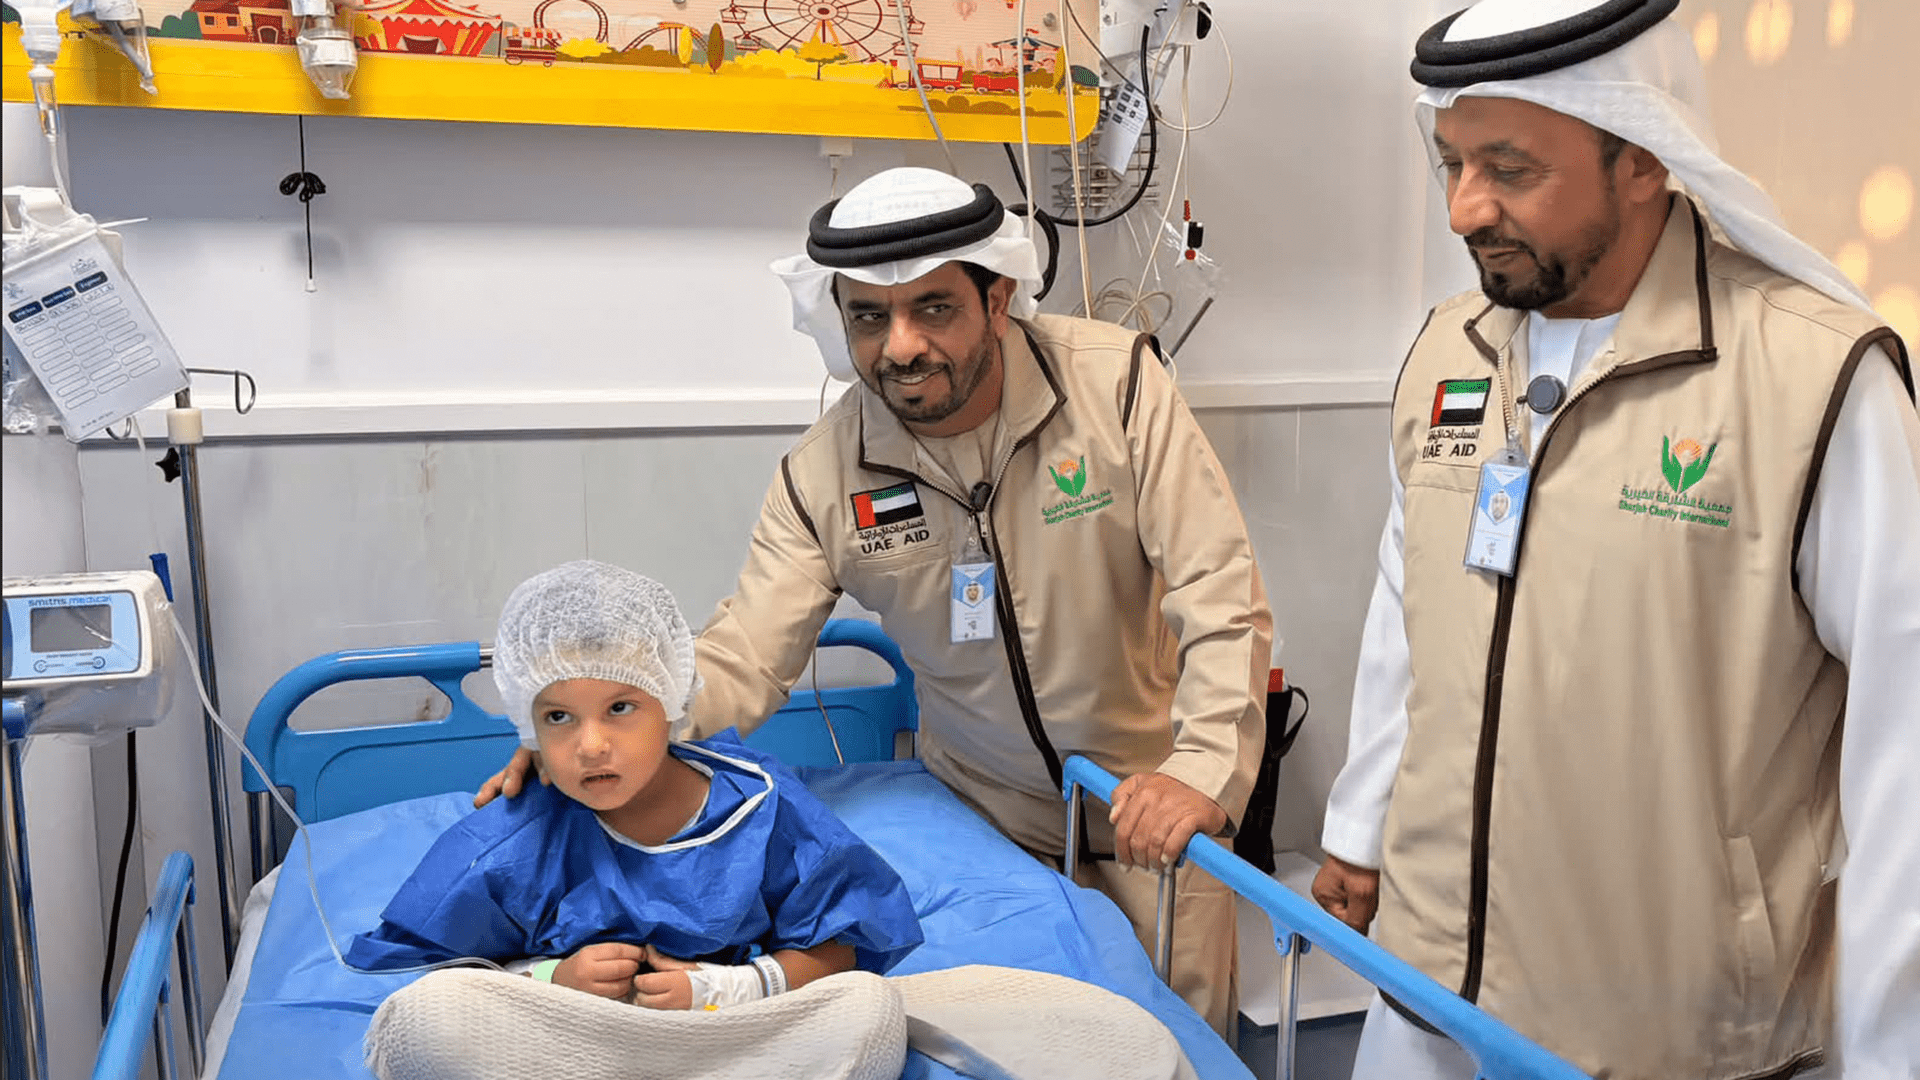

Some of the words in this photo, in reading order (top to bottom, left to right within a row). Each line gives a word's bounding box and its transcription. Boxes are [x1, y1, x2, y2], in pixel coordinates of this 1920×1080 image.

[1422, 444, 1443, 459] UAE
[1449, 443, 1477, 457] AID
[861, 538, 895, 554] UAE
[903, 529, 930, 545] AID
